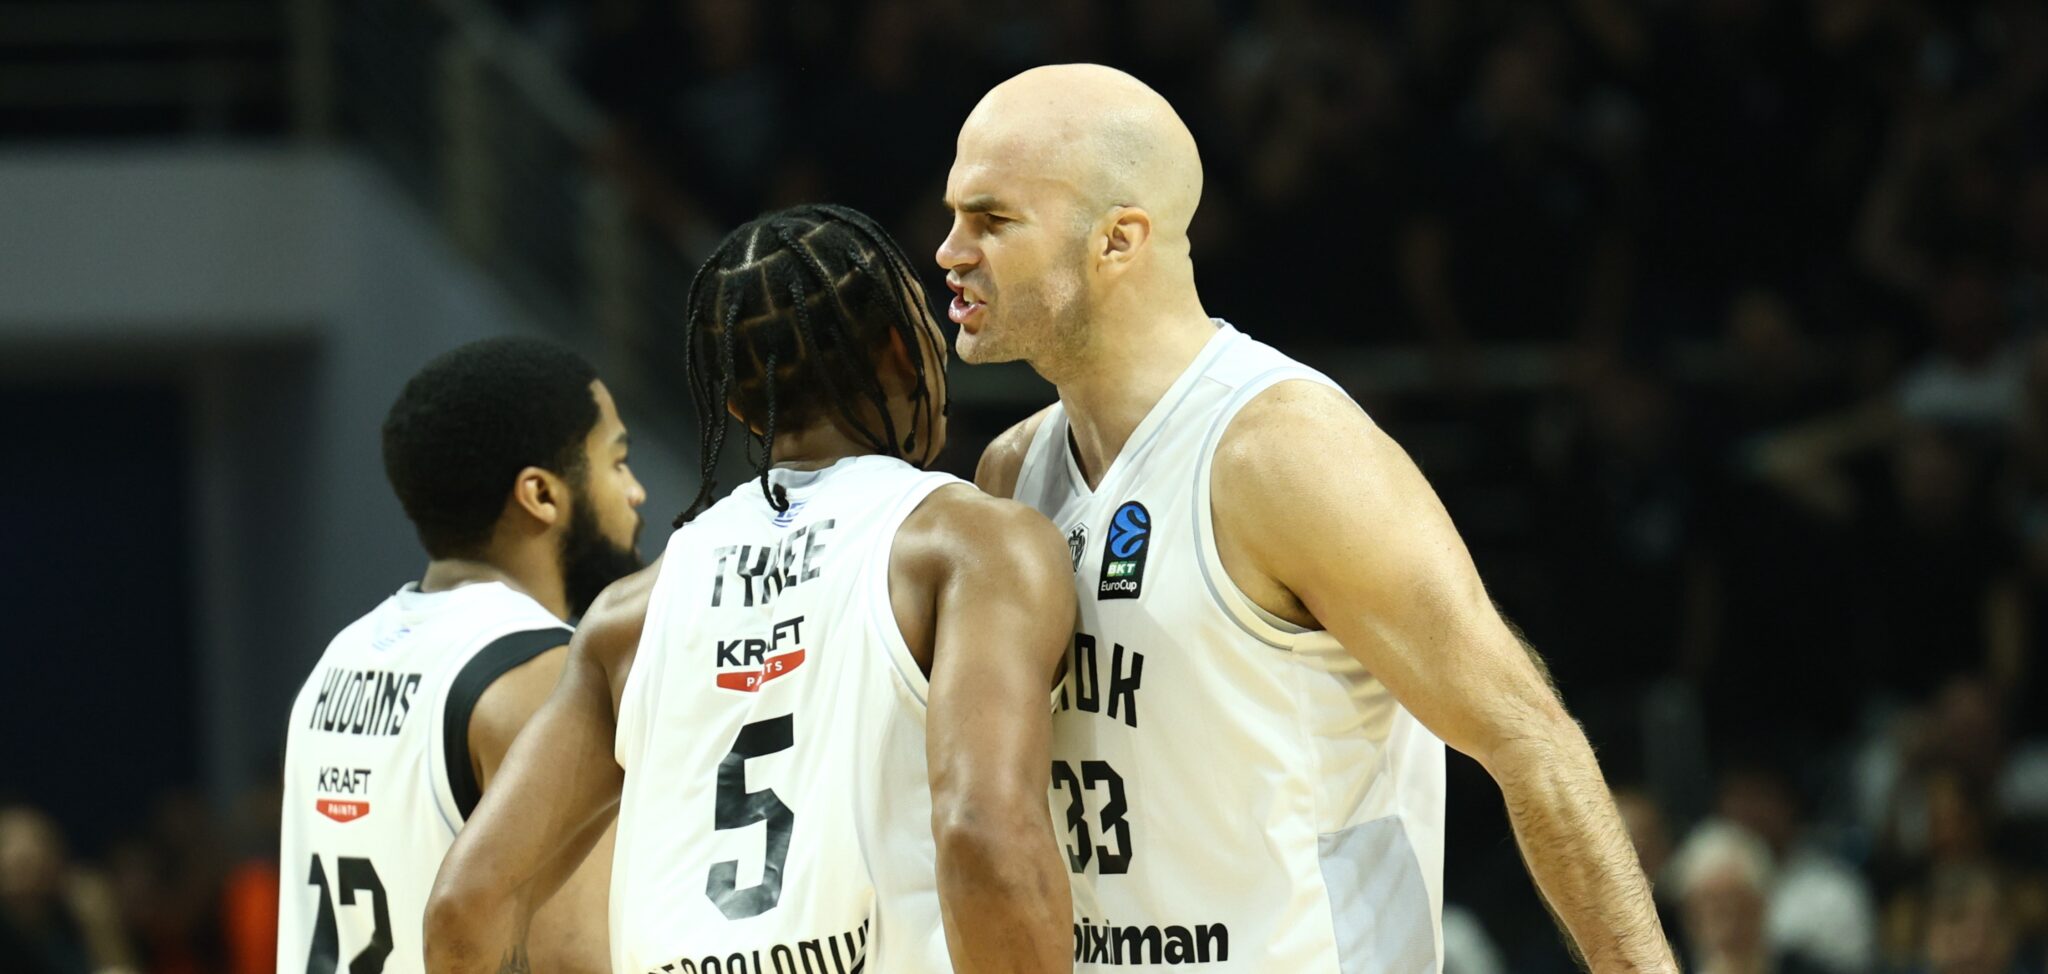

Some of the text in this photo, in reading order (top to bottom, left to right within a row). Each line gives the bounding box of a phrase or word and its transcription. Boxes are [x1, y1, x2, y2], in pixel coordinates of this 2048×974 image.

[1100, 579, 1138, 592] EuroCup
[1106, 562, 1136, 576] BKT
[716, 615, 805, 667] KRFT
[309, 667, 422, 736] HUDGINS
[317, 766, 372, 794] KRAFT
[705, 712, 794, 921] 5
[1051, 760, 1132, 875] 33
